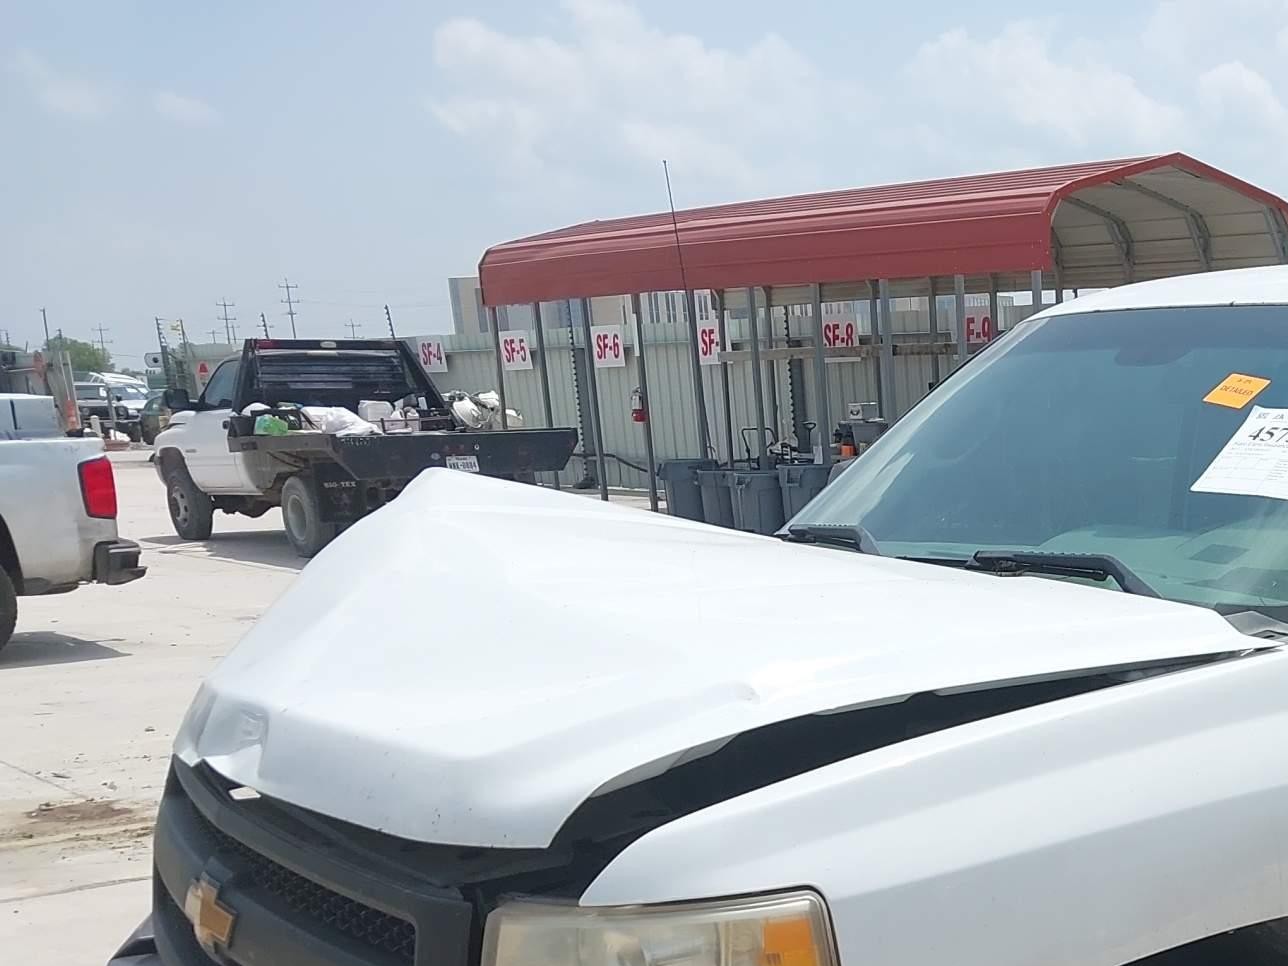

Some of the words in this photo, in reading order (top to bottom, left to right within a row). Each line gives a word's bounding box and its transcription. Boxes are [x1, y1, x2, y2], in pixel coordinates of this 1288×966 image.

[823, 322, 854, 347] SF-8
[966, 316, 992, 342] F-9
[421, 342, 443, 366] SF-4
[503, 338, 527, 363] SF-5
[596, 333, 620, 360] SF-6
